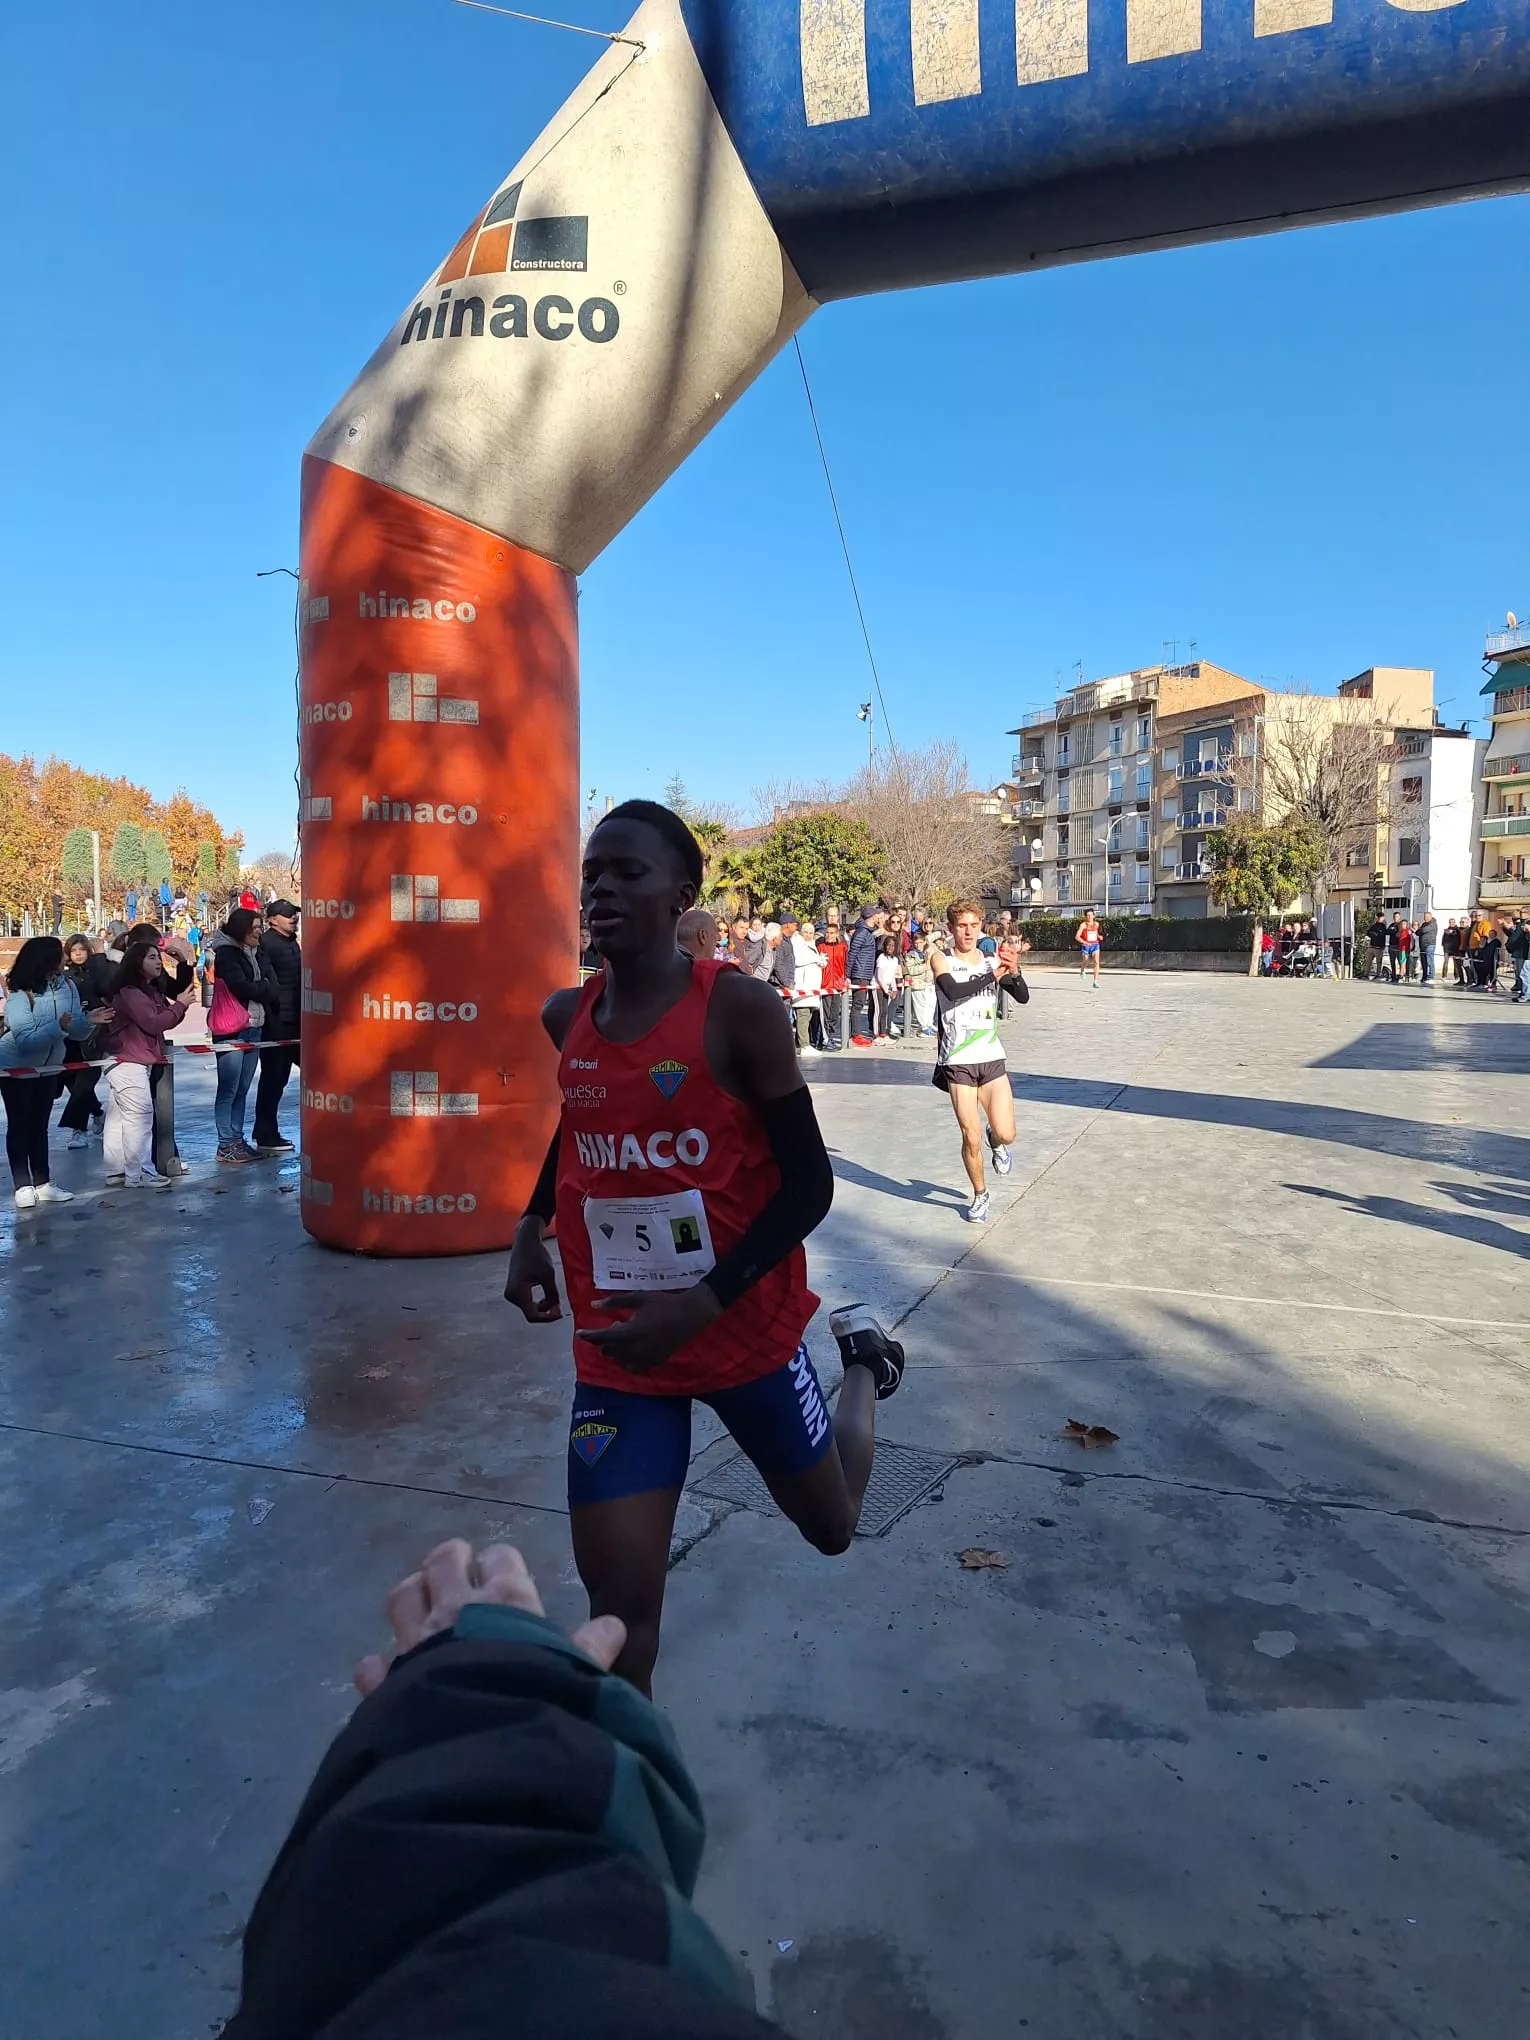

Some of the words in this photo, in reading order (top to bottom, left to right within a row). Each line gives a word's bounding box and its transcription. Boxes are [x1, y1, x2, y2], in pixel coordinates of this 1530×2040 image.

[512, 259, 584, 270] Constructora
[400, 288, 620, 344] hinaco
[359, 591, 477, 623] hinaco
[301, 700, 353, 725] inaco
[361, 795, 478, 825] hinaco
[302, 898, 356, 920] inaco
[362, 993, 478, 1022] hinaco
[301, 1081, 354, 1114] inaco
[574, 1128, 709, 1171] HINACO
[362, 1188, 477, 1214] hinaco
[635, 1224, 652, 1252] 5
